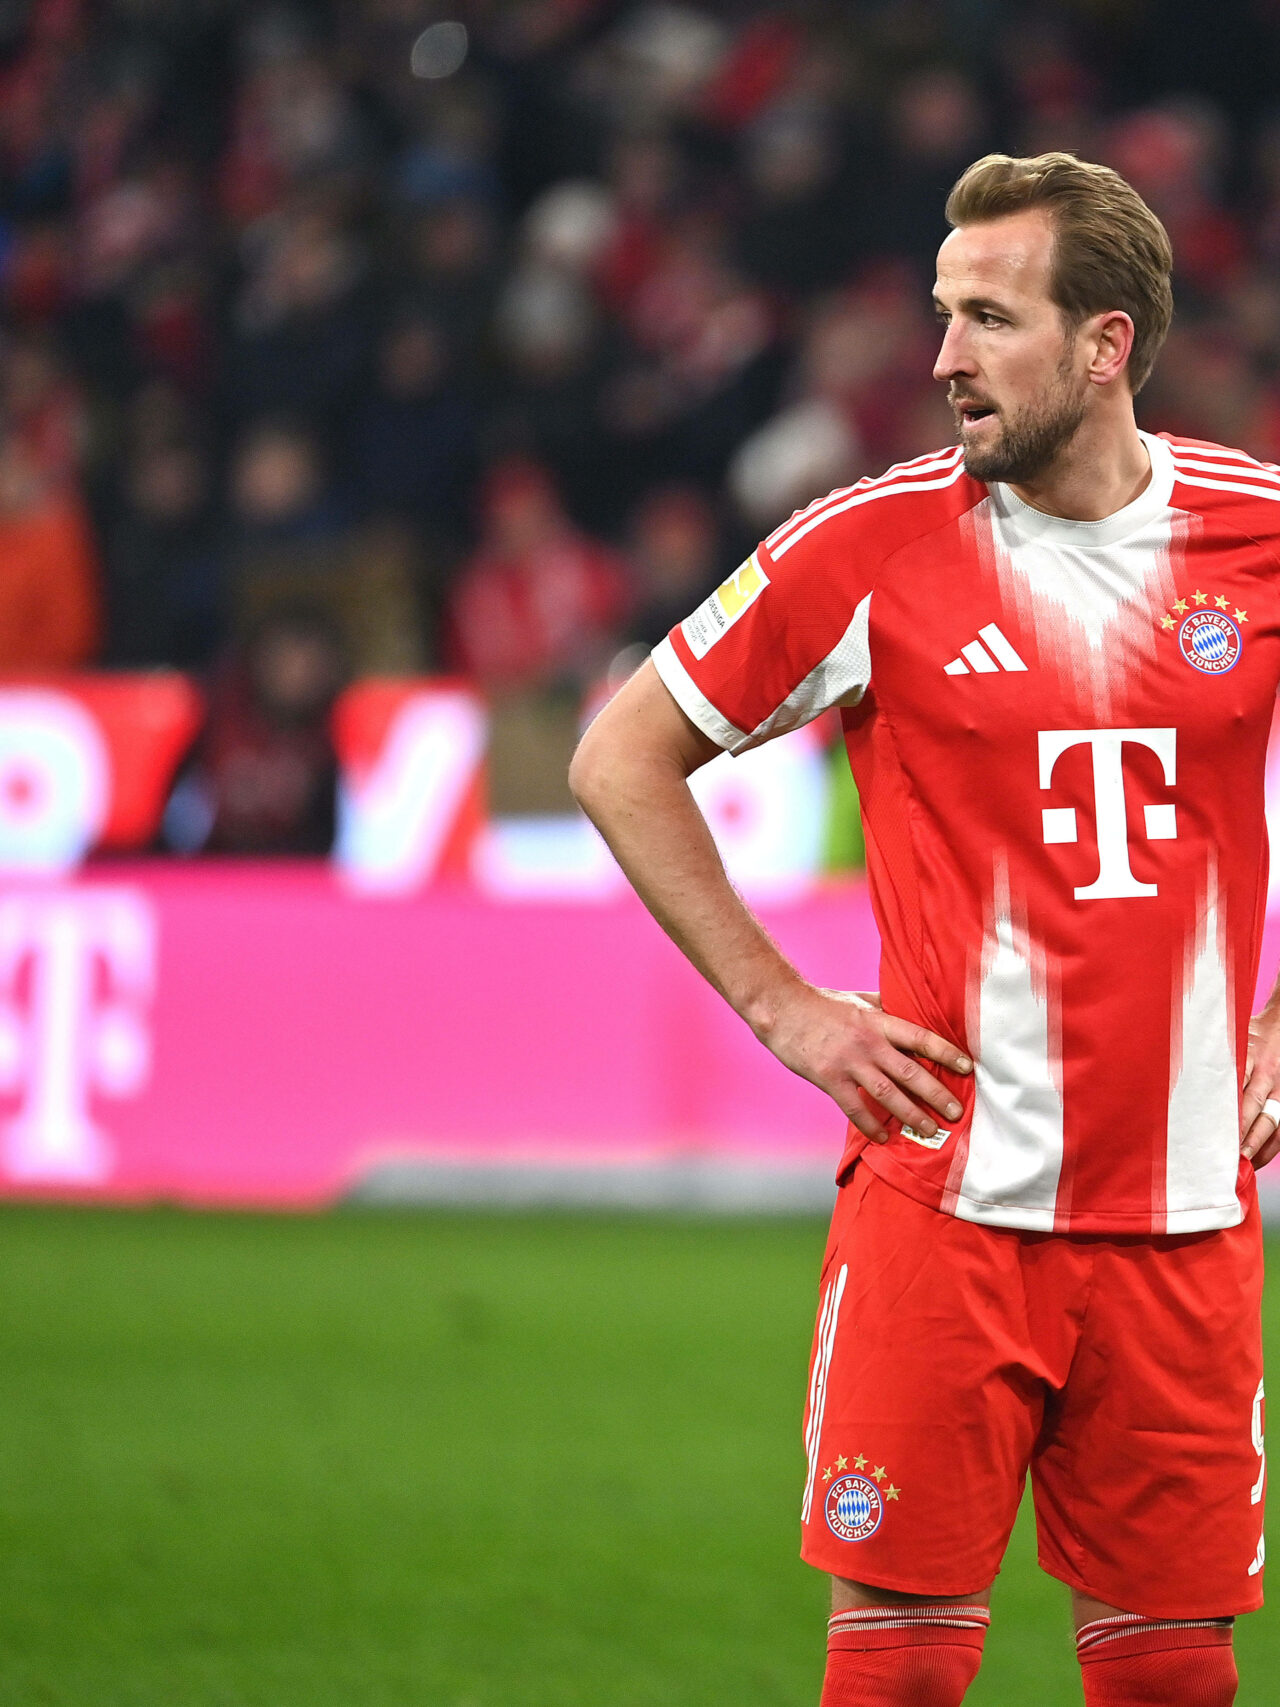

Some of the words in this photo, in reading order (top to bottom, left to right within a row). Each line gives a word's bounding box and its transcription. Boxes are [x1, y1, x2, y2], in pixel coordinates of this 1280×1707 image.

[1183, 626, 1194, 641] FC
[1192, 614, 1234, 637] BAYERN
[1187, 646, 1237, 670] MÜNCHEN
[1037, 727, 1177, 900] T
[831, 1484, 844, 1499] FC
[845, 1480, 879, 1509] BAYERN
